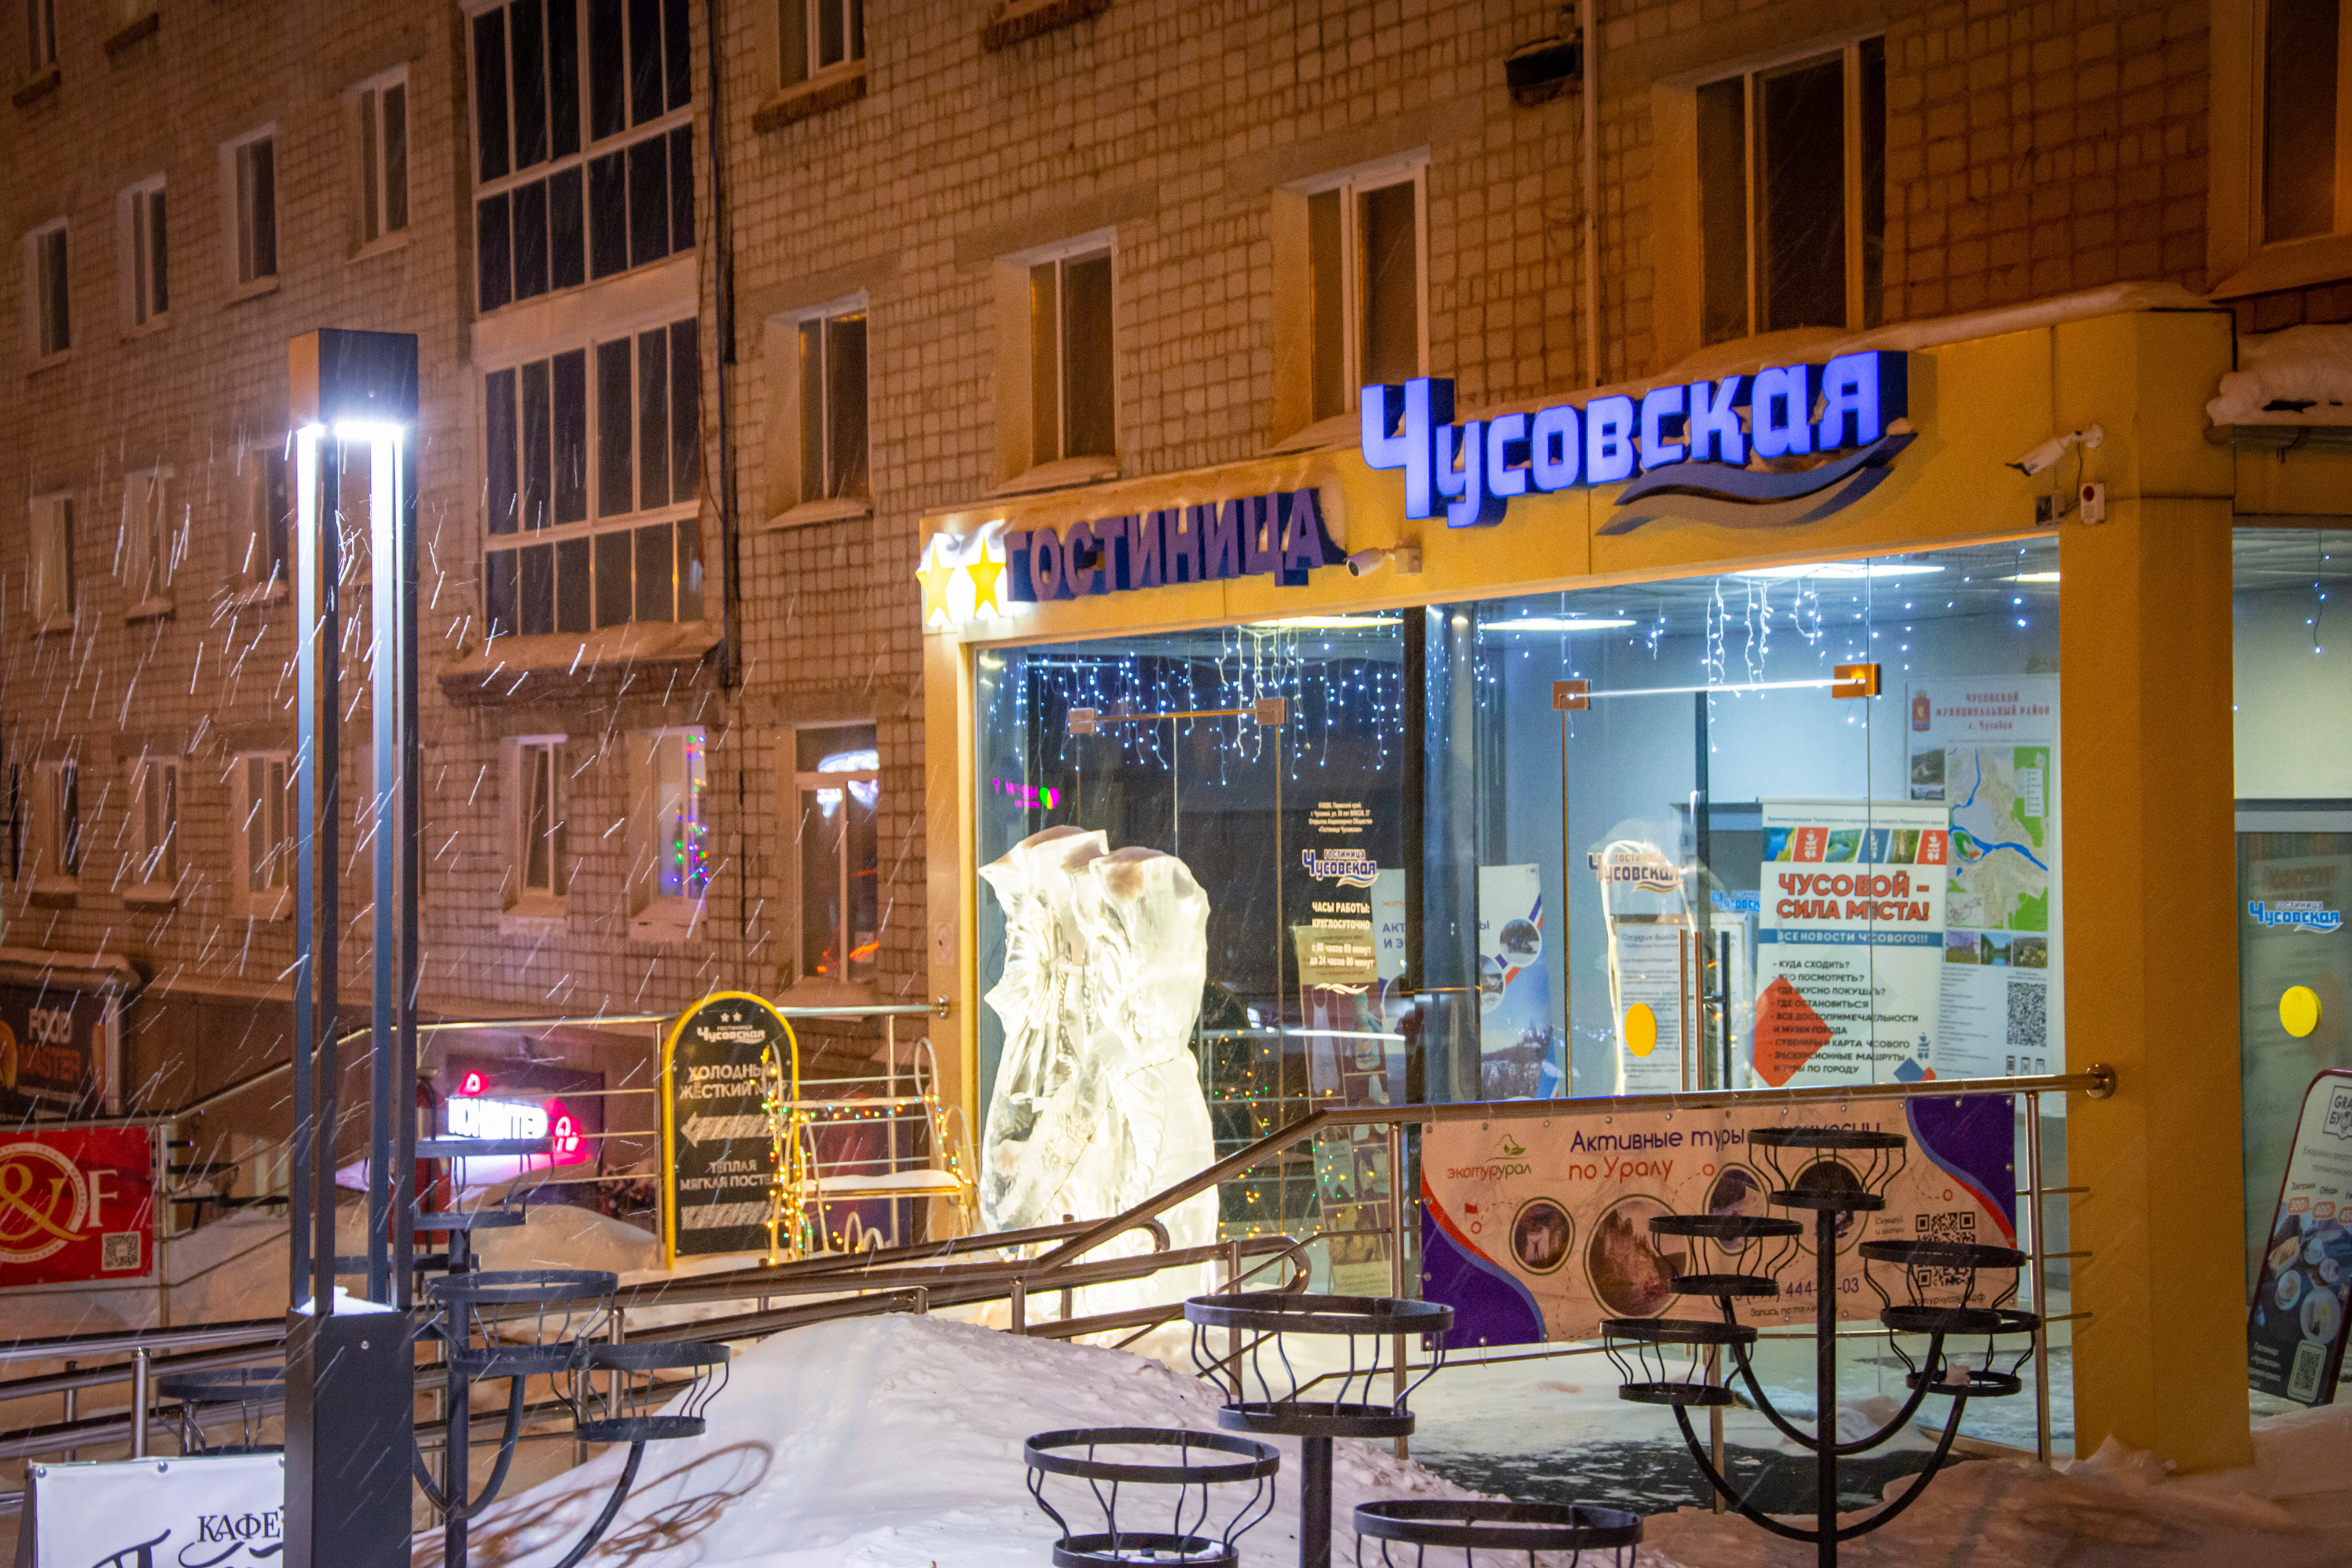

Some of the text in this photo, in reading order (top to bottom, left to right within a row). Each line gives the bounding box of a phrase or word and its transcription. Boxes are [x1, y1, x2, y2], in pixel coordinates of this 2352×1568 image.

[1361, 350, 1882, 528] Чусовская
[1004, 488, 1325, 602] ГОСТИНИЦА
[1779, 871, 1909, 898] ЧУСОВОЙ
[1312, 902, 1370, 914] ЧАСЫ РАБОТЫ:
[1777, 899, 1840, 919] СИЛА
[1312, 918, 1370, 929] КРУГЛОСУТОЧНО
[1383, 938, 1392, 948] И
[1777, 932, 1798, 941] ВСЕ
[1800, 932, 1855, 942] НОВОСТИ
[1352, 946, 1371, 956] минут
[1310, 957, 1318, 966] до
[1319, 955, 1326, 965] 24
[1355, 960, 1374, 969] минут
[1794, 1000, 1869, 1008] ОСТАНОВИТЬСЯ
[1795, 1013, 1918, 1022] ДОСТОПРИМЕЧАЕЛЬНОСТИ
[29, 1008, 72, 1044] FOOD
[1812, 1026, 1847, 1034] ГОРОДА
[1866, 1040, 1910, 1049] ЧСОВОГО
[1856, 1053, 1905, 1062] МАШРУТЫ
[1823, 1065, 1859, 1074] ГОРОДУ
[1570, 1128, 1744, 1153] Активные туры
[1569, 1156, 1673, 1184] по Уралу
[730, 1173, 775, 1187] ПОСТЕ
[1786, 1277, 1859, 1297] 444--03
[1751, 1308, 1779, 1317] Запись
[197, 1512, 280, 1543] КАФЕ
